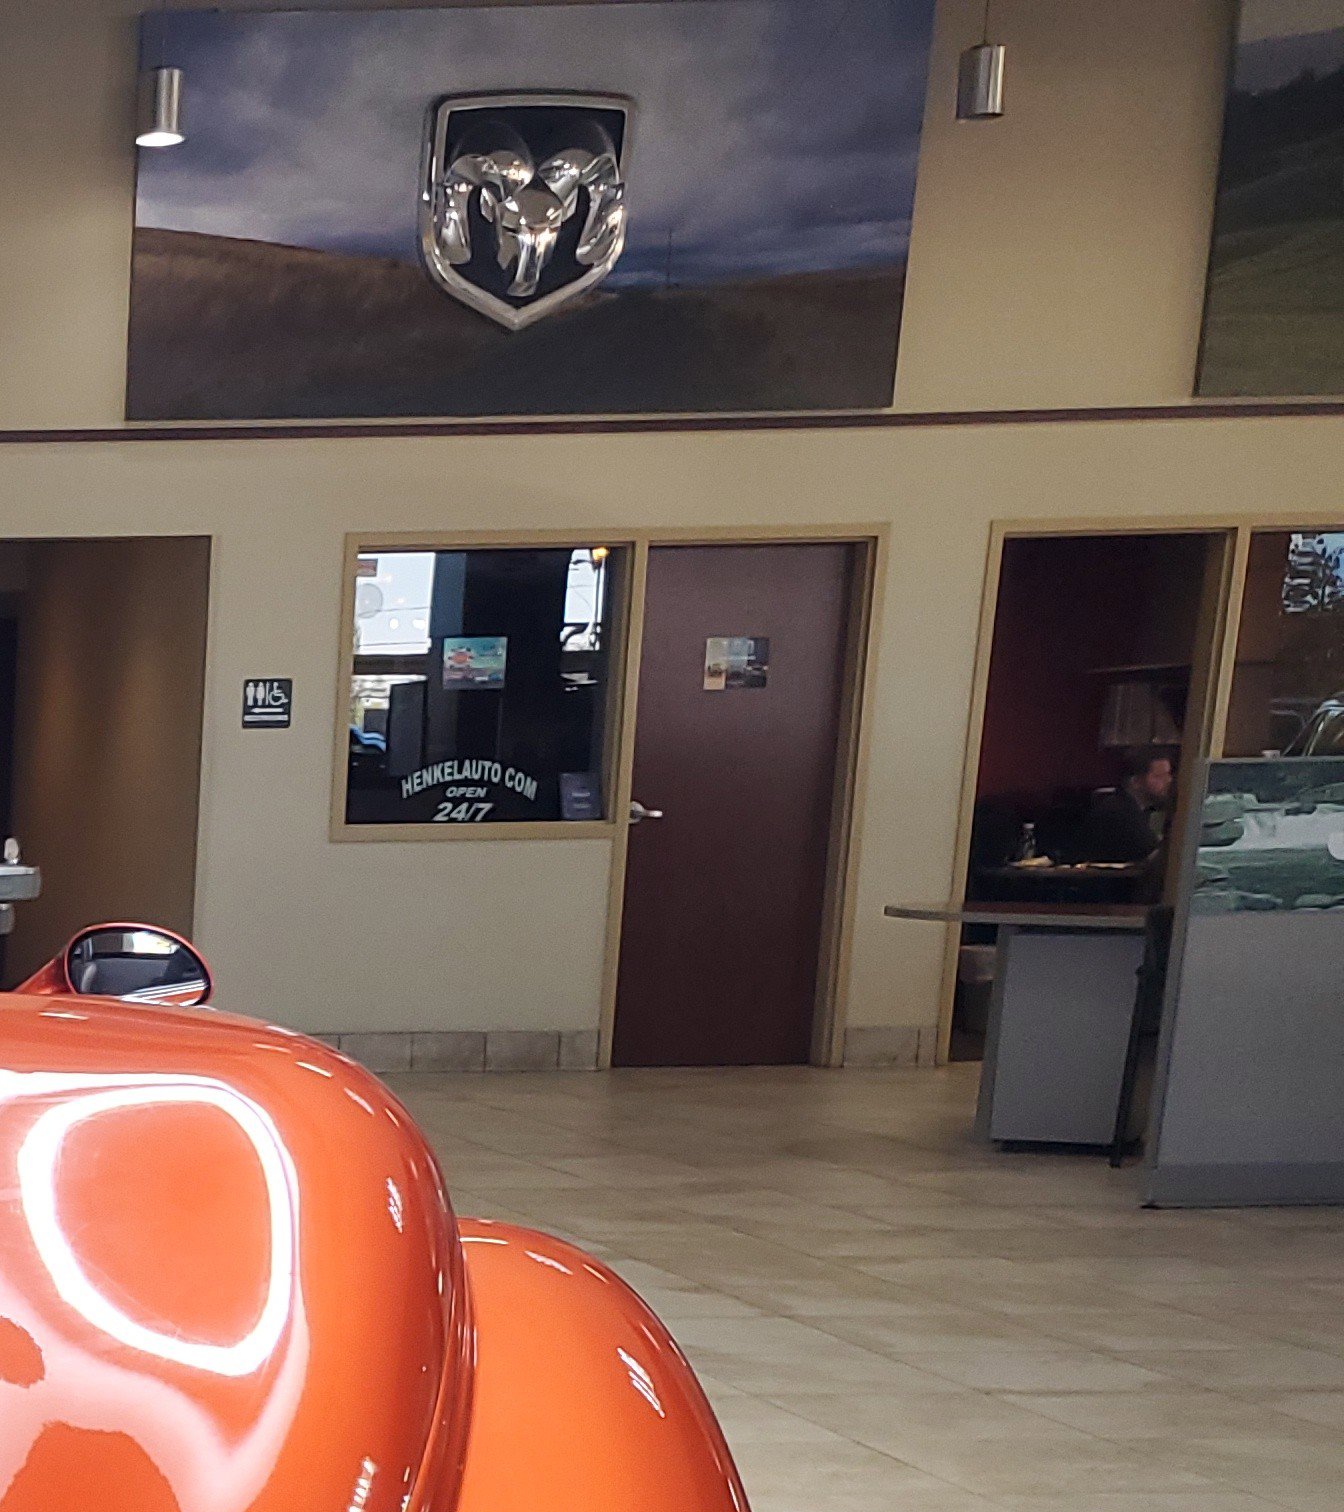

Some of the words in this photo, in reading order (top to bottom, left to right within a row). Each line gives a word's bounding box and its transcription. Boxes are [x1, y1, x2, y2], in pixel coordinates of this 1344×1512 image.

[401, 759, 502, 799] HENKELAUTO
[505, 767, 538, 801] COM
[445, 787, 487, 798] OPEN
[432, 802, 494, 822] 24/7
